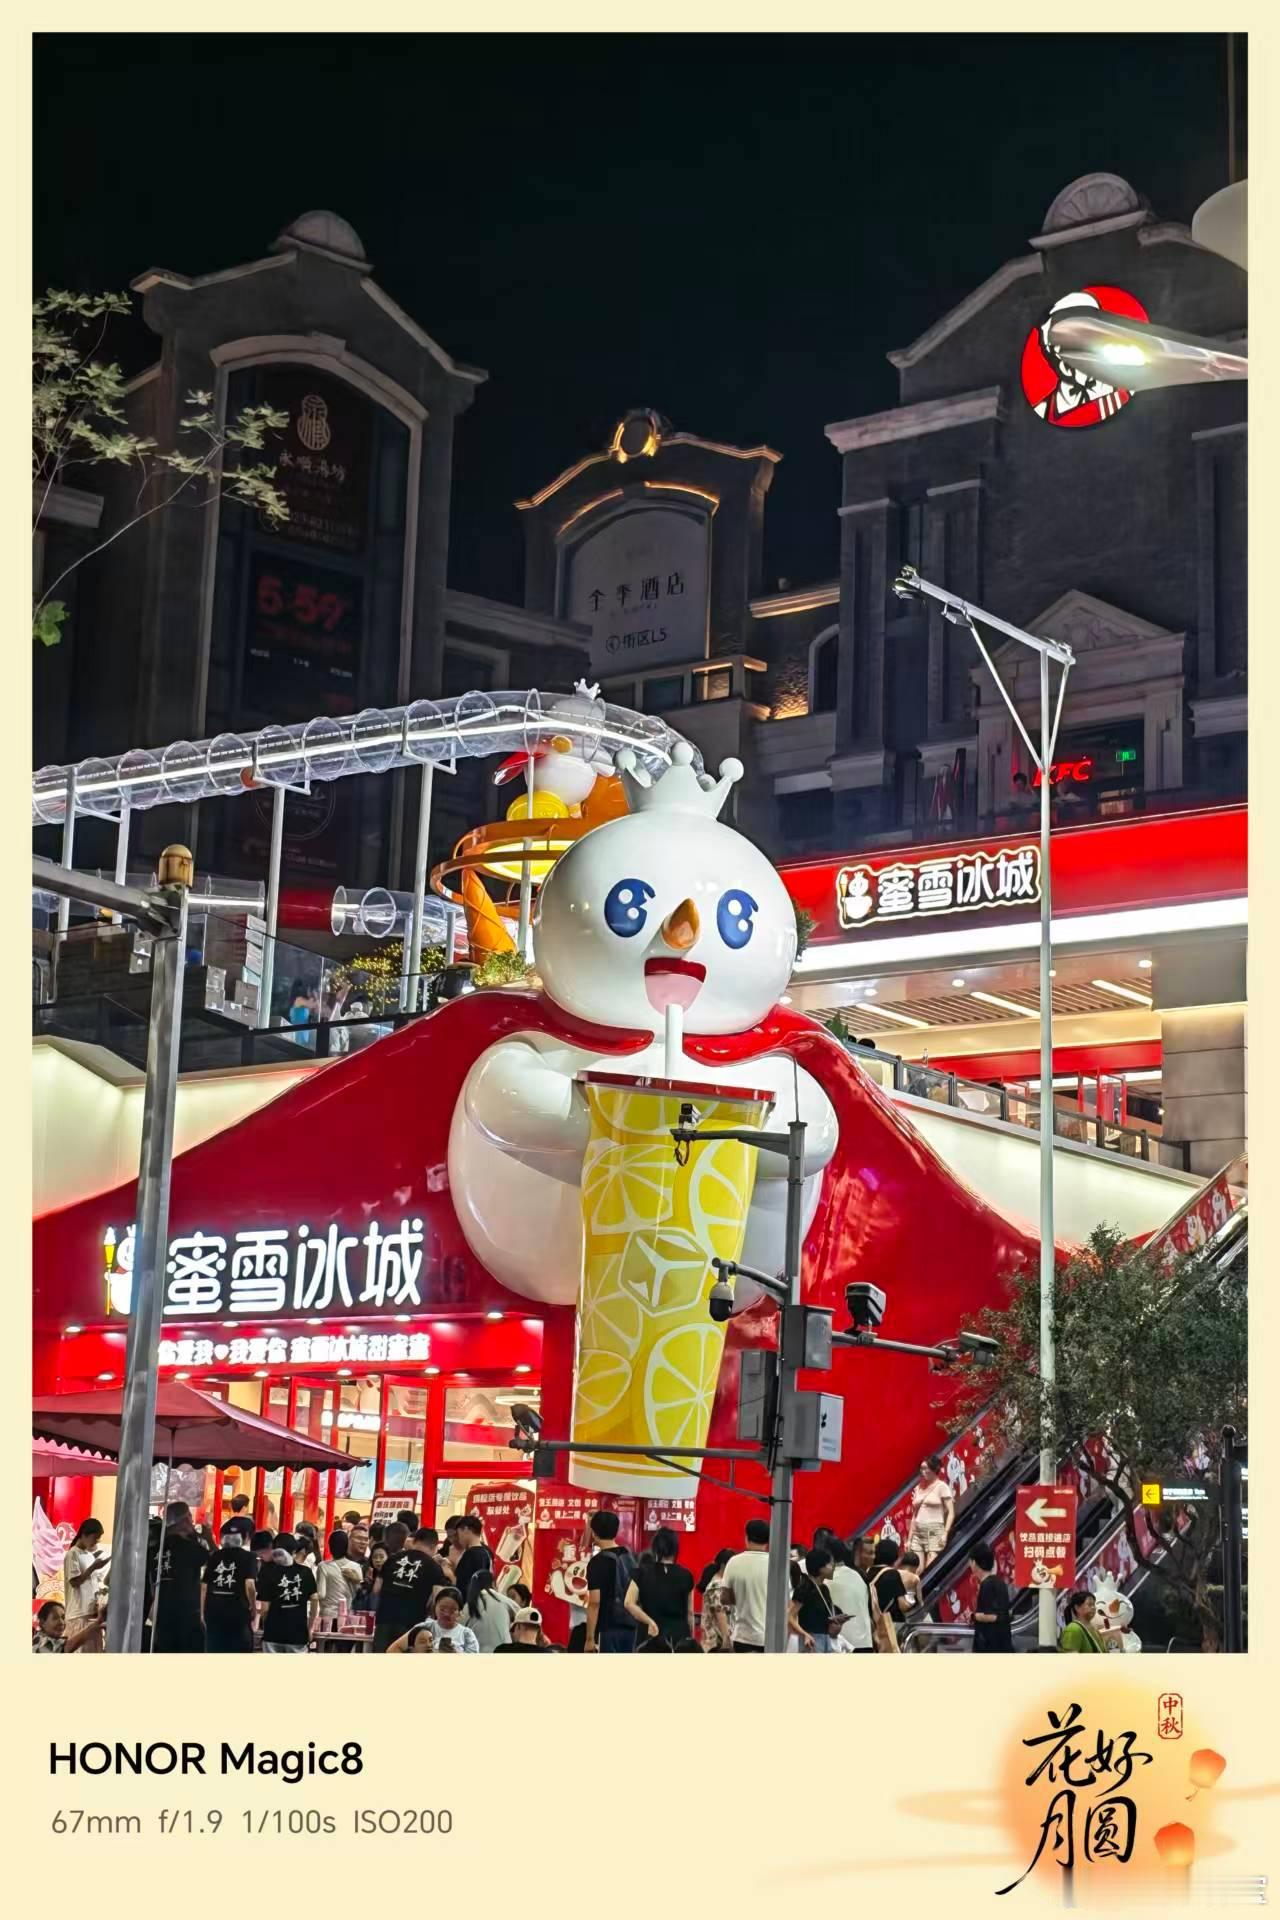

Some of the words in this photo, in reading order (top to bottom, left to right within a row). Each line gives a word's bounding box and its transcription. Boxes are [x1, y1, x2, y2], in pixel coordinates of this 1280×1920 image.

[1032, 759, 1091, 787] KFC
[877, 851, 1034, 914] 蜜雪冰城
[163, 1218, 424, 1316] 蜜雪冰城
[1023, 1546, 1067, 1559] 扫码点餐
